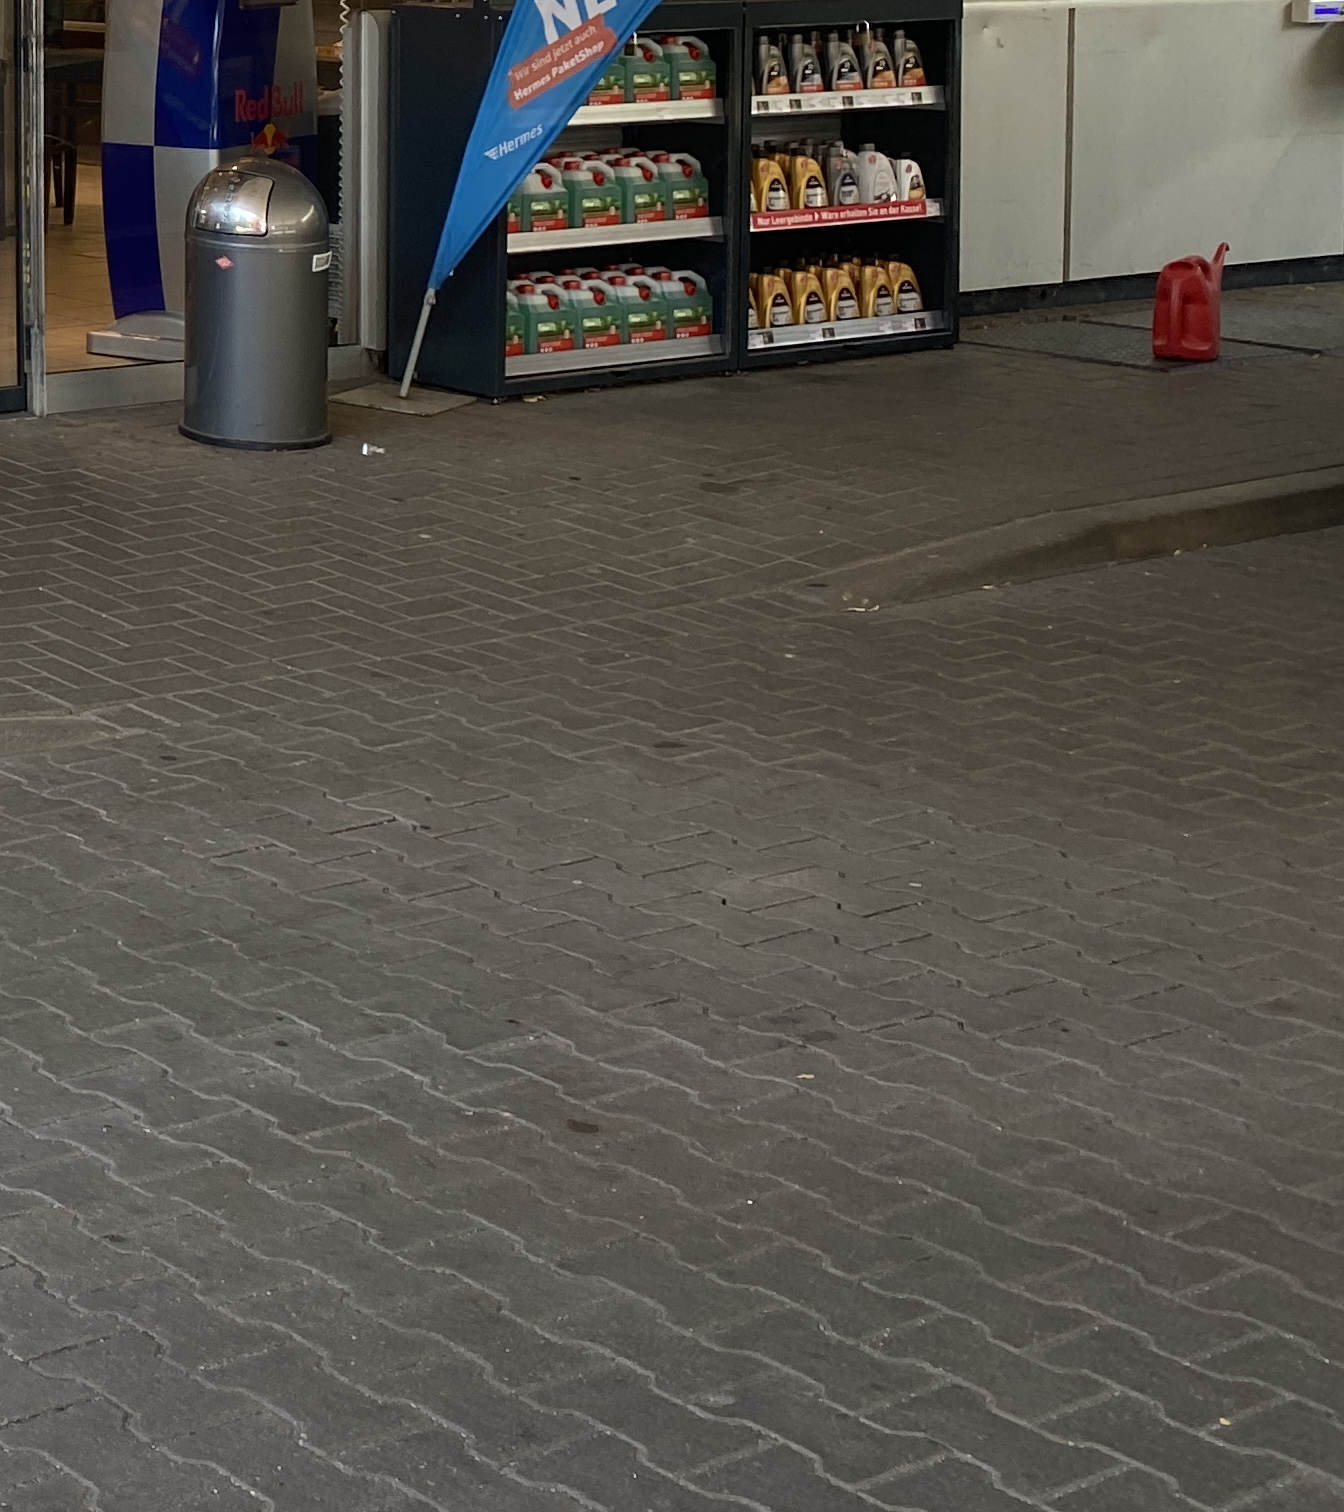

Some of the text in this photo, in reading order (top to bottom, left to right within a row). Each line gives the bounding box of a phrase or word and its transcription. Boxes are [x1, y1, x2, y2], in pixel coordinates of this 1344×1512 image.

[531, 52, 551, 72] sind
[553, 39, 574, 60] jetzt
[574, 25, 597, 45] auch
[513, 40, 604, 100] Hermes PaketShop
[235, 84, 269, 122] Red
[499, 124, 543, 157] Hermes
[757, 215, 770, 225] Nur
[821, 210, 838, 220] Ware
[868, 206, 879, 216] Sie
[889, 205, 899, 215] der
